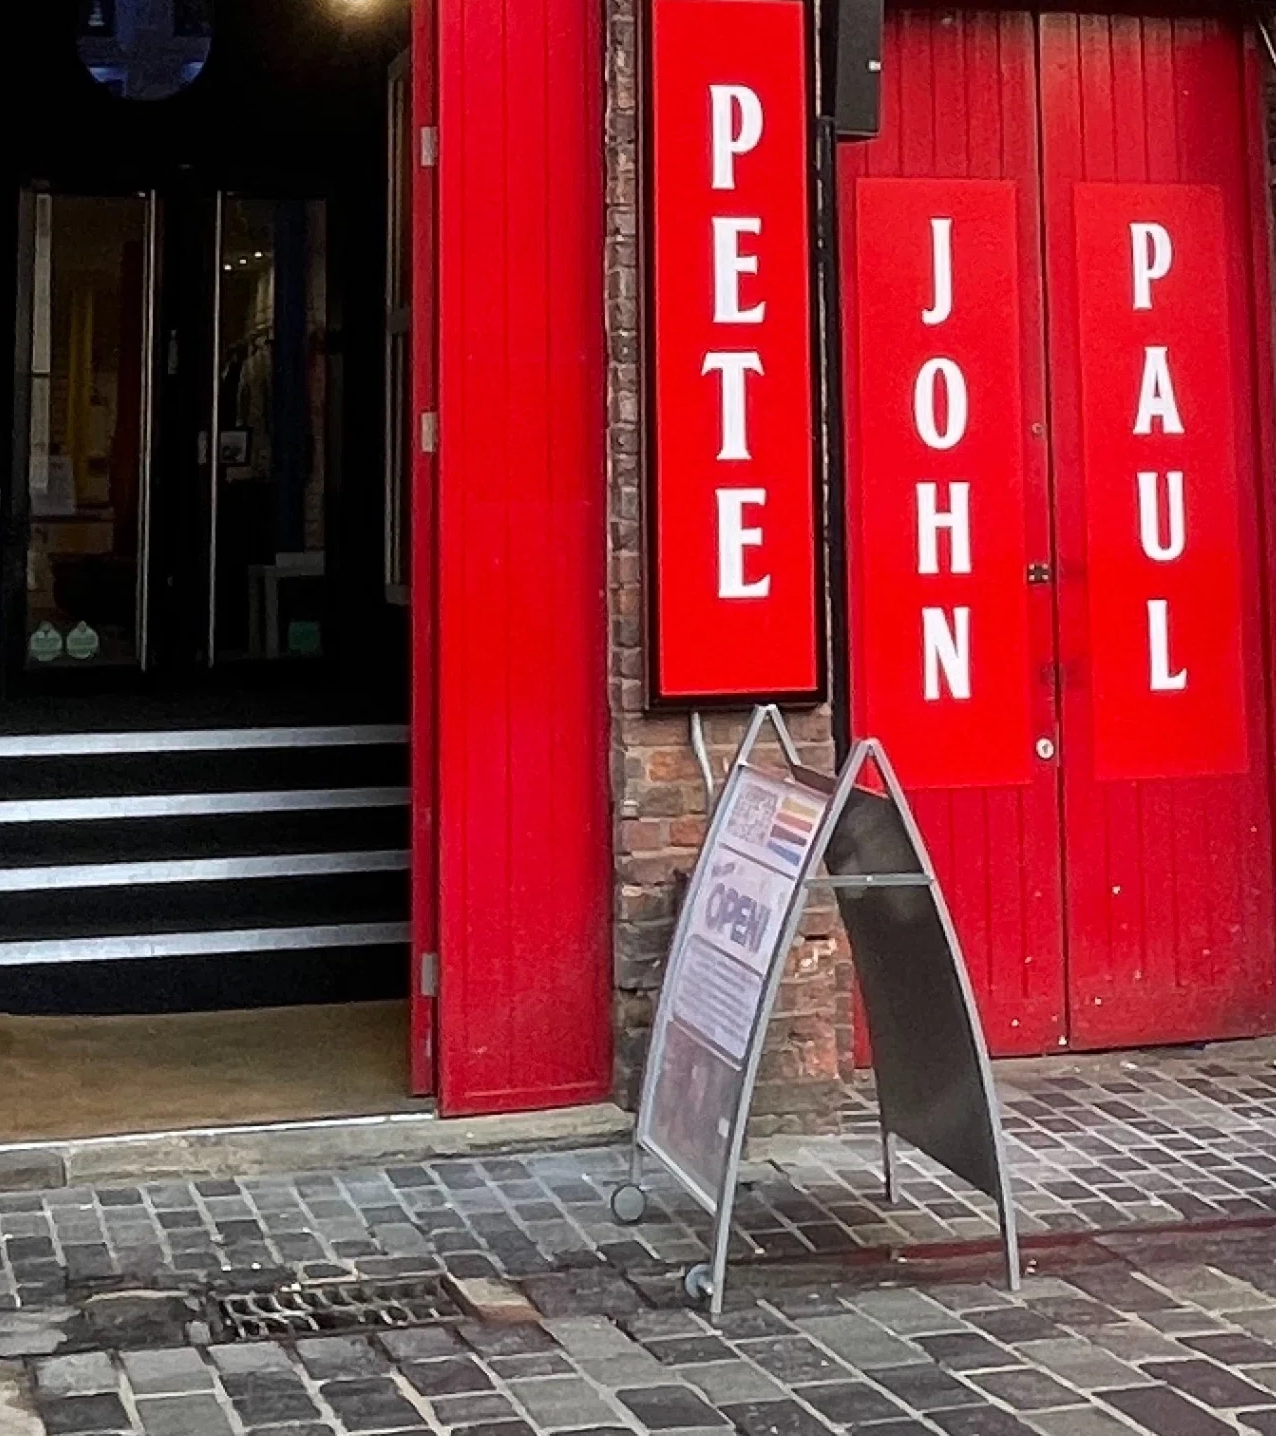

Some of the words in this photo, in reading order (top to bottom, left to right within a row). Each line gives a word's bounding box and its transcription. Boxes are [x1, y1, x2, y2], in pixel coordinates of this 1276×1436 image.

[702, 83, 772, 600] PETE
[913, 217, 971, 702] JOHN
[1130, 221, 1188, 693] PAUL
